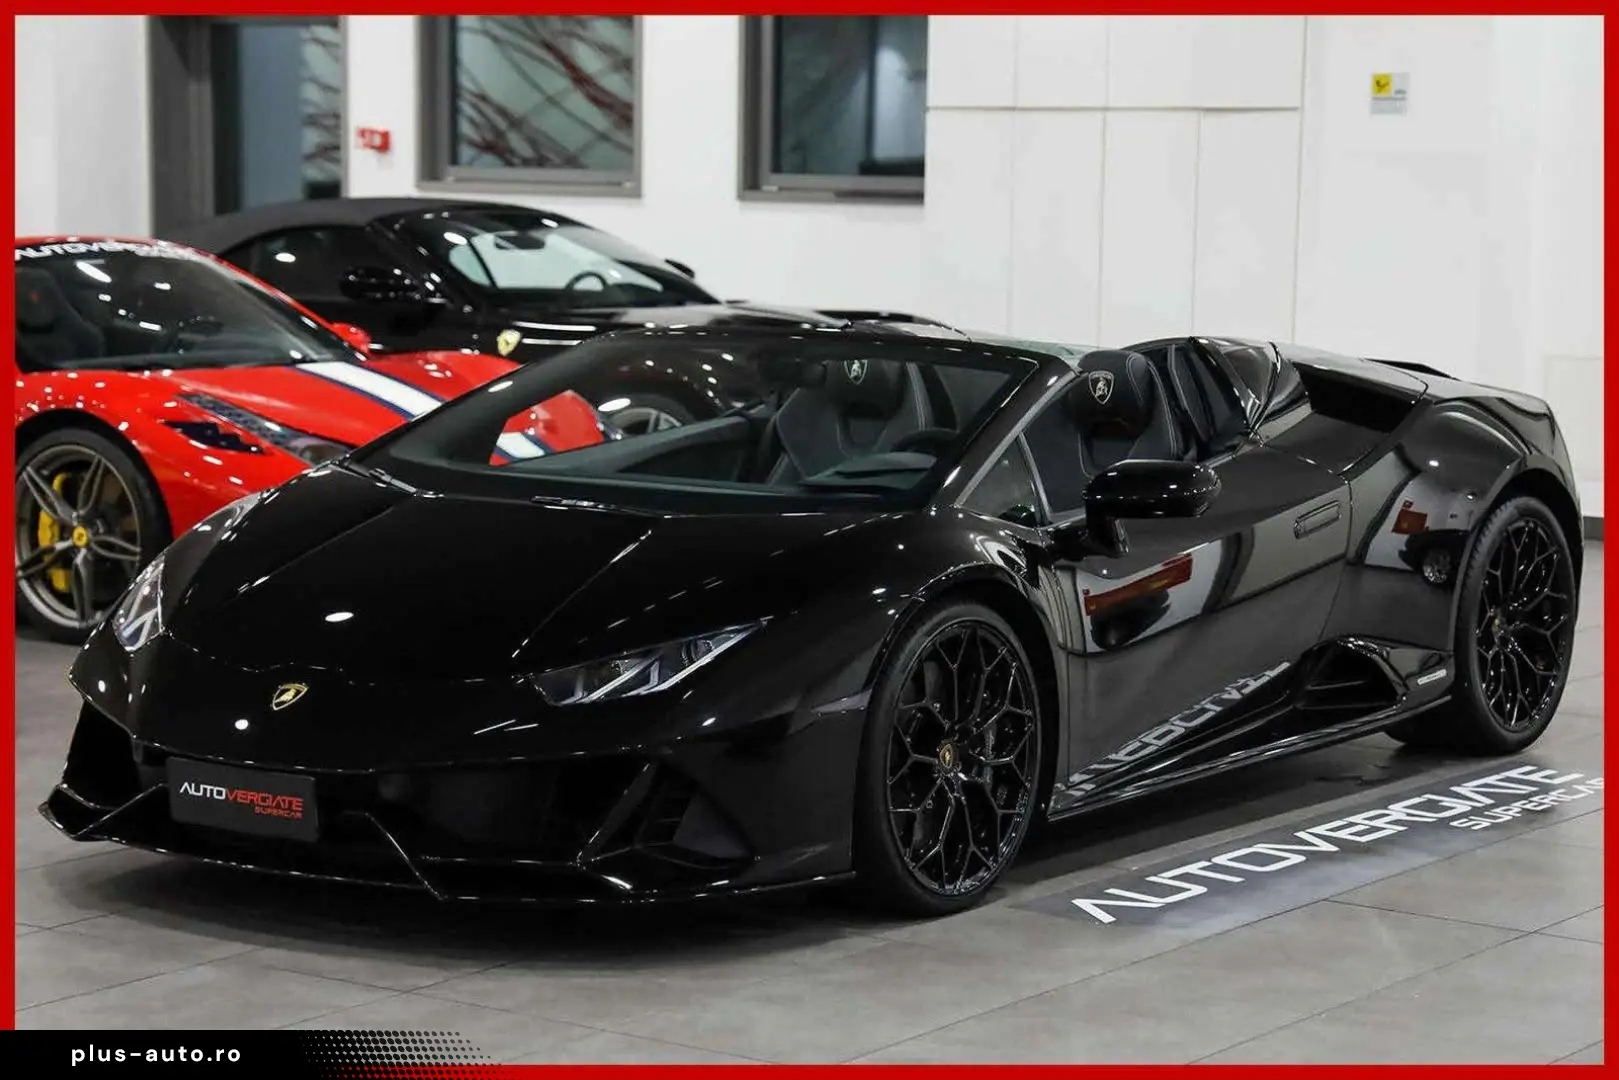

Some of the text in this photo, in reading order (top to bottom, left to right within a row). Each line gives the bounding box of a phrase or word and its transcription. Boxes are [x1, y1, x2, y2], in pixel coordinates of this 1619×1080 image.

[179, 782, 304, 811] AUTOVERGIATE
[254, 806, 302, 819] SUPERCAR
[1072, 765, 1585, 924] AUTOVERGIATE
